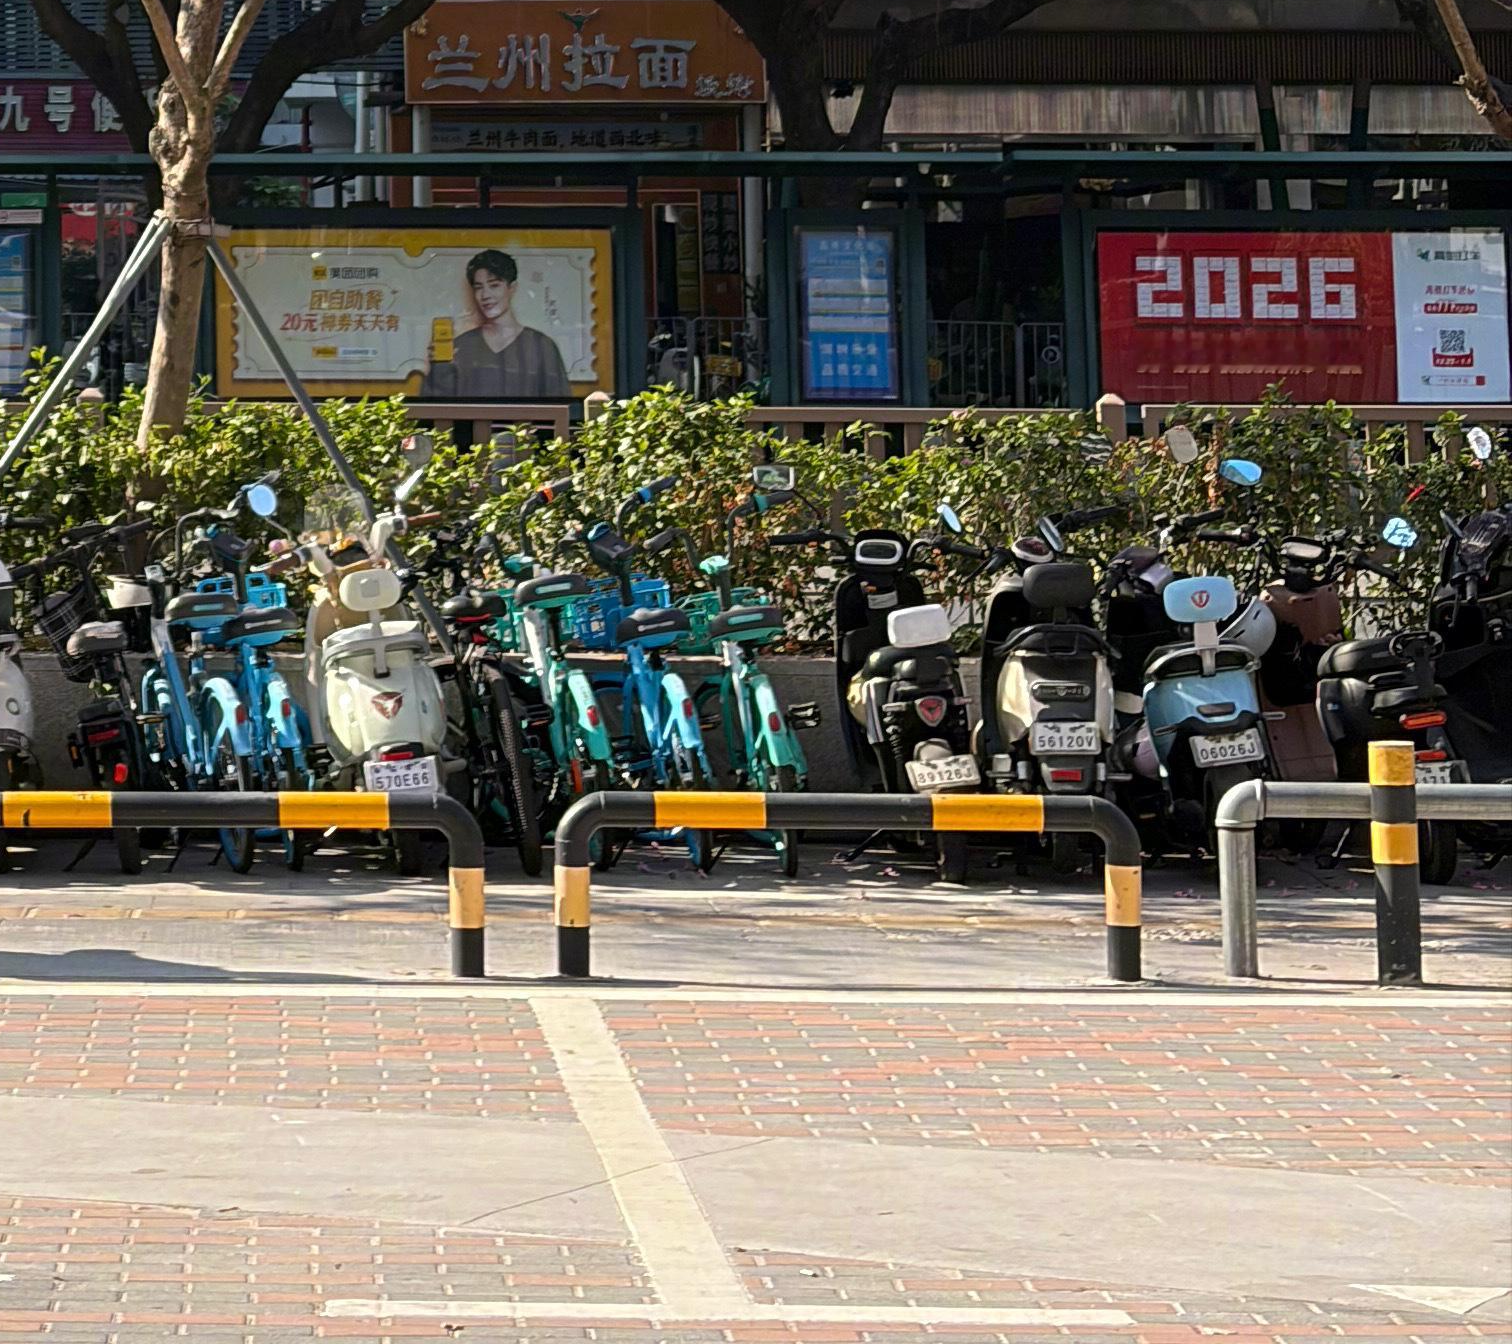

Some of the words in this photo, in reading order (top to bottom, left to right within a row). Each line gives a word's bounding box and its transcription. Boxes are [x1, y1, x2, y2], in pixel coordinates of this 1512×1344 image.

[422, 33, 696, 92] 兰州拉面
[1135, 257, 1356, 319] 2026
[1038, 735, 1094, 748] 56120V
[1200, 741, 1256, 761] 06026J
[375, 772, 430, 789] 570E66
